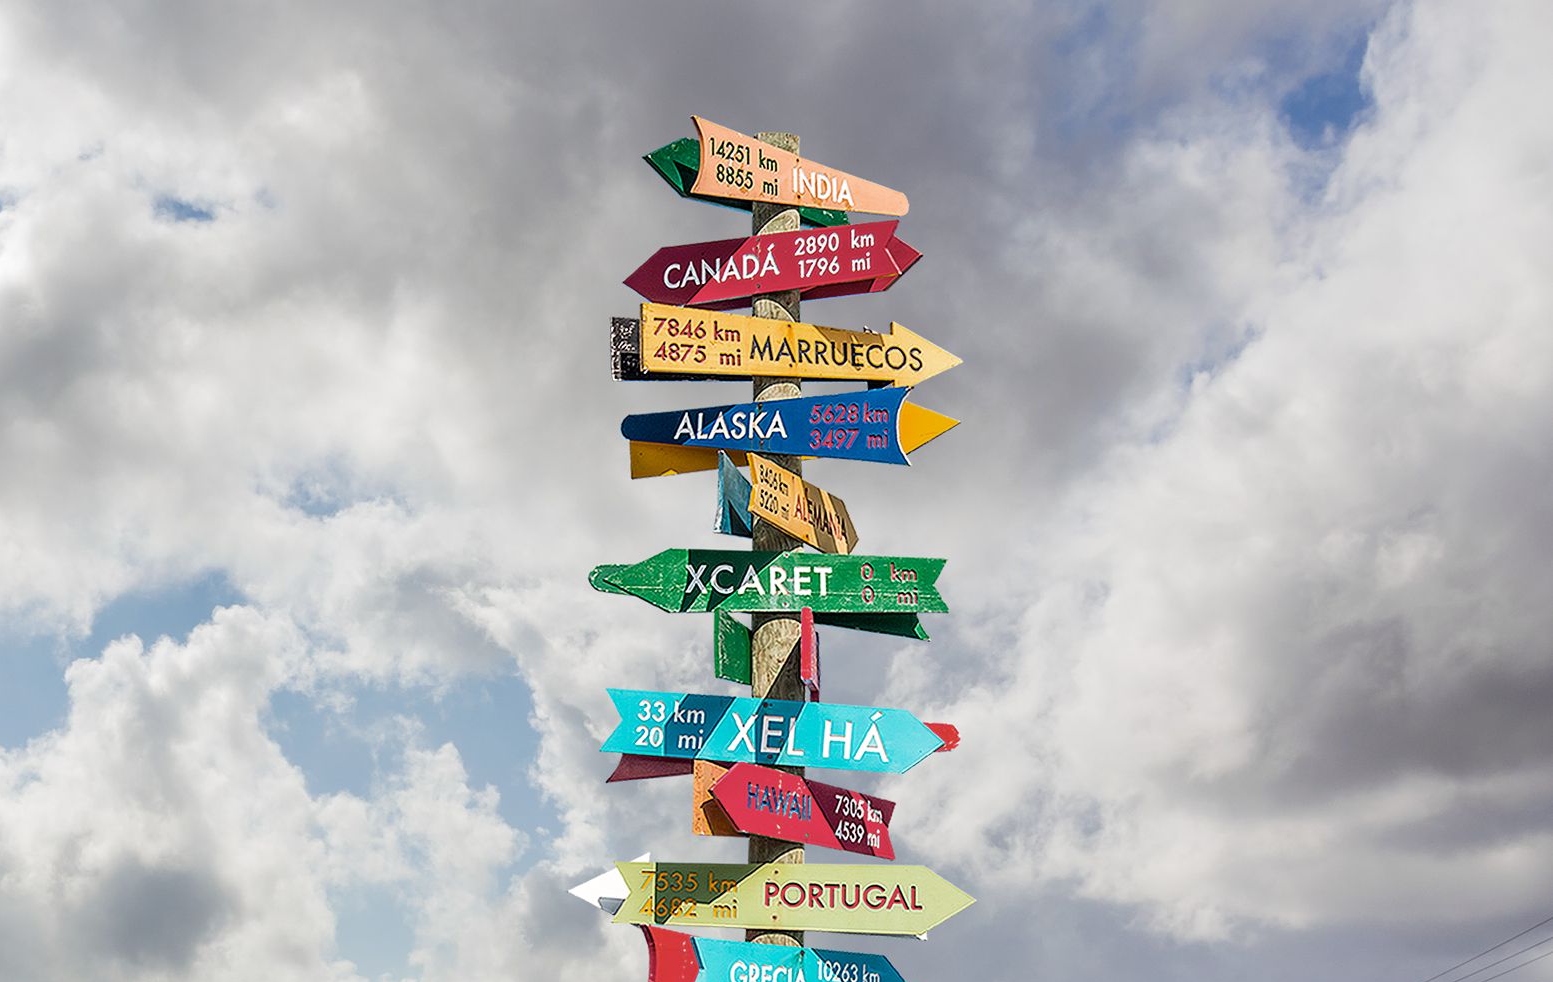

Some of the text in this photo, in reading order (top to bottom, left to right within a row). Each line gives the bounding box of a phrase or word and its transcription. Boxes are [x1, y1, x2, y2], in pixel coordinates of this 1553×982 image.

[709, 137, 779, 173] 14251 km
[716, 163, 779, 197] 8855 mi
[792, 166, 855, 207] INDIA
[794, 229, 875, 256] 2890 km
[663, 244, 780, 289] CANADÁ
[797, 253, 871, 278] 1796 mi
[653, 318, 741, 343] 7846 km
[653, 342, 742, 367] 4875 mi
[749, 334, 923, 372] MARRUECOS
[673, 410, 788, 440] ALASKA
[809, 402, 889, 424] 5628 km
[809, 429, 888, 449] 3497 mi
[684, 563, 833, 597] XCARET
[860, 561, 918, 583] 0 km
[861, 585, 919, 605] 0 mi
[637, 700, 705, 725] 33 km
[634, 726, 704, 751] 20 mi
[727, 711, 890, 763] XEL HÁ
[747, 782, 812, 821] HAWAII
[834, 794, 884, 825] 7305 km
[834, 821, 881, 849] 4539 mi
[640, 869, 738, 894] 7535 km
[638, 895, 738, 919] 4682 mi
[764, 881, 924, 911] PORTUGAL
